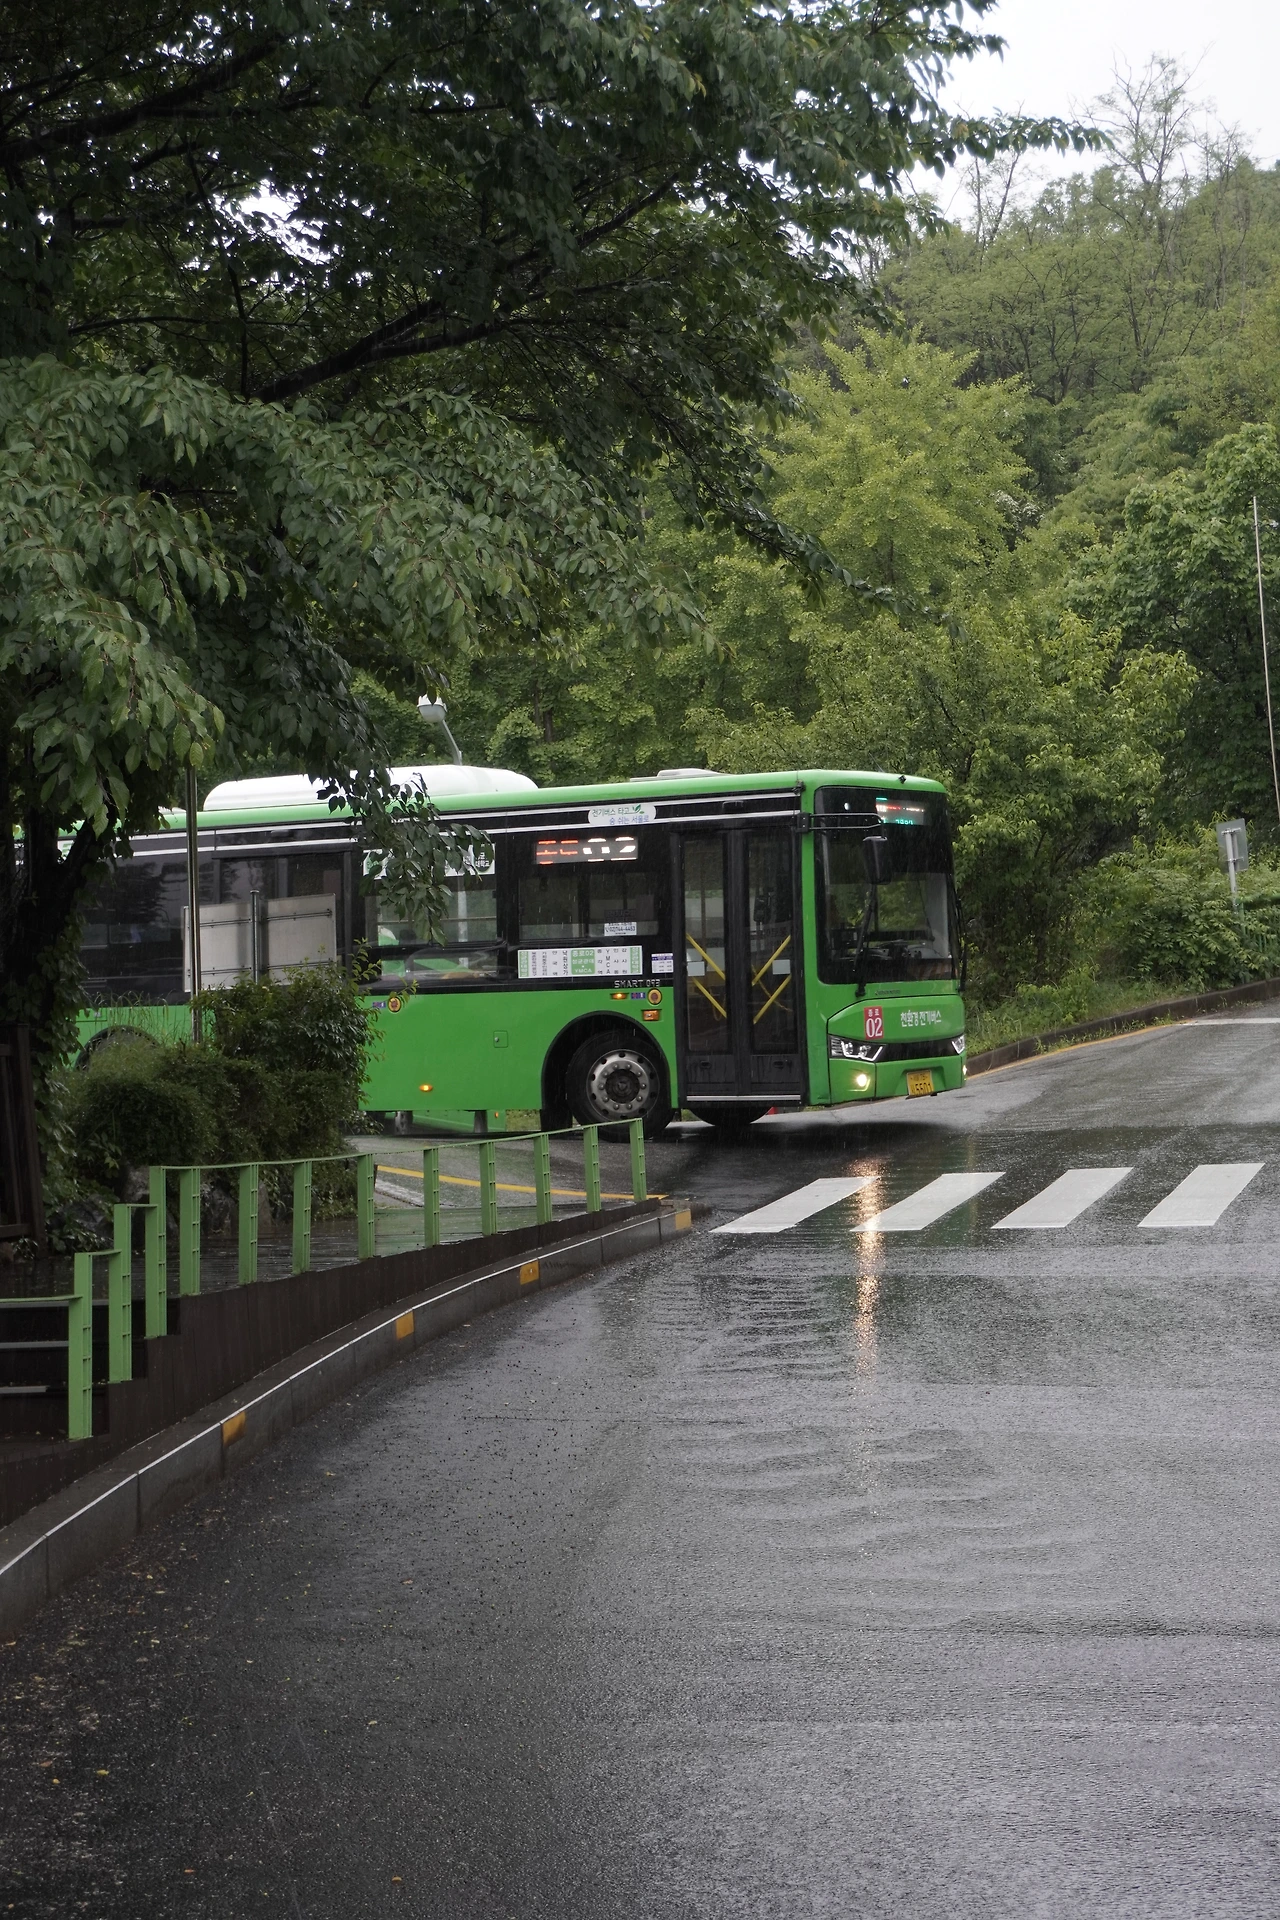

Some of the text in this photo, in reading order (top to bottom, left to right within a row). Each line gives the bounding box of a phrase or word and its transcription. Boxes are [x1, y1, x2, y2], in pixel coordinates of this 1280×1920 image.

[592, 808, 616, 818] 전기버스
[572, 949, 594, 958] 종로02
[614, 979, 643, 988] SMART
[868, 1008, 880, 1017] 종로
[900, 1009, 942, 1028] 친환경 전기버스
[865, 1017, 883, 1038] 02
[915, 1082, 934, 1096] 5501
